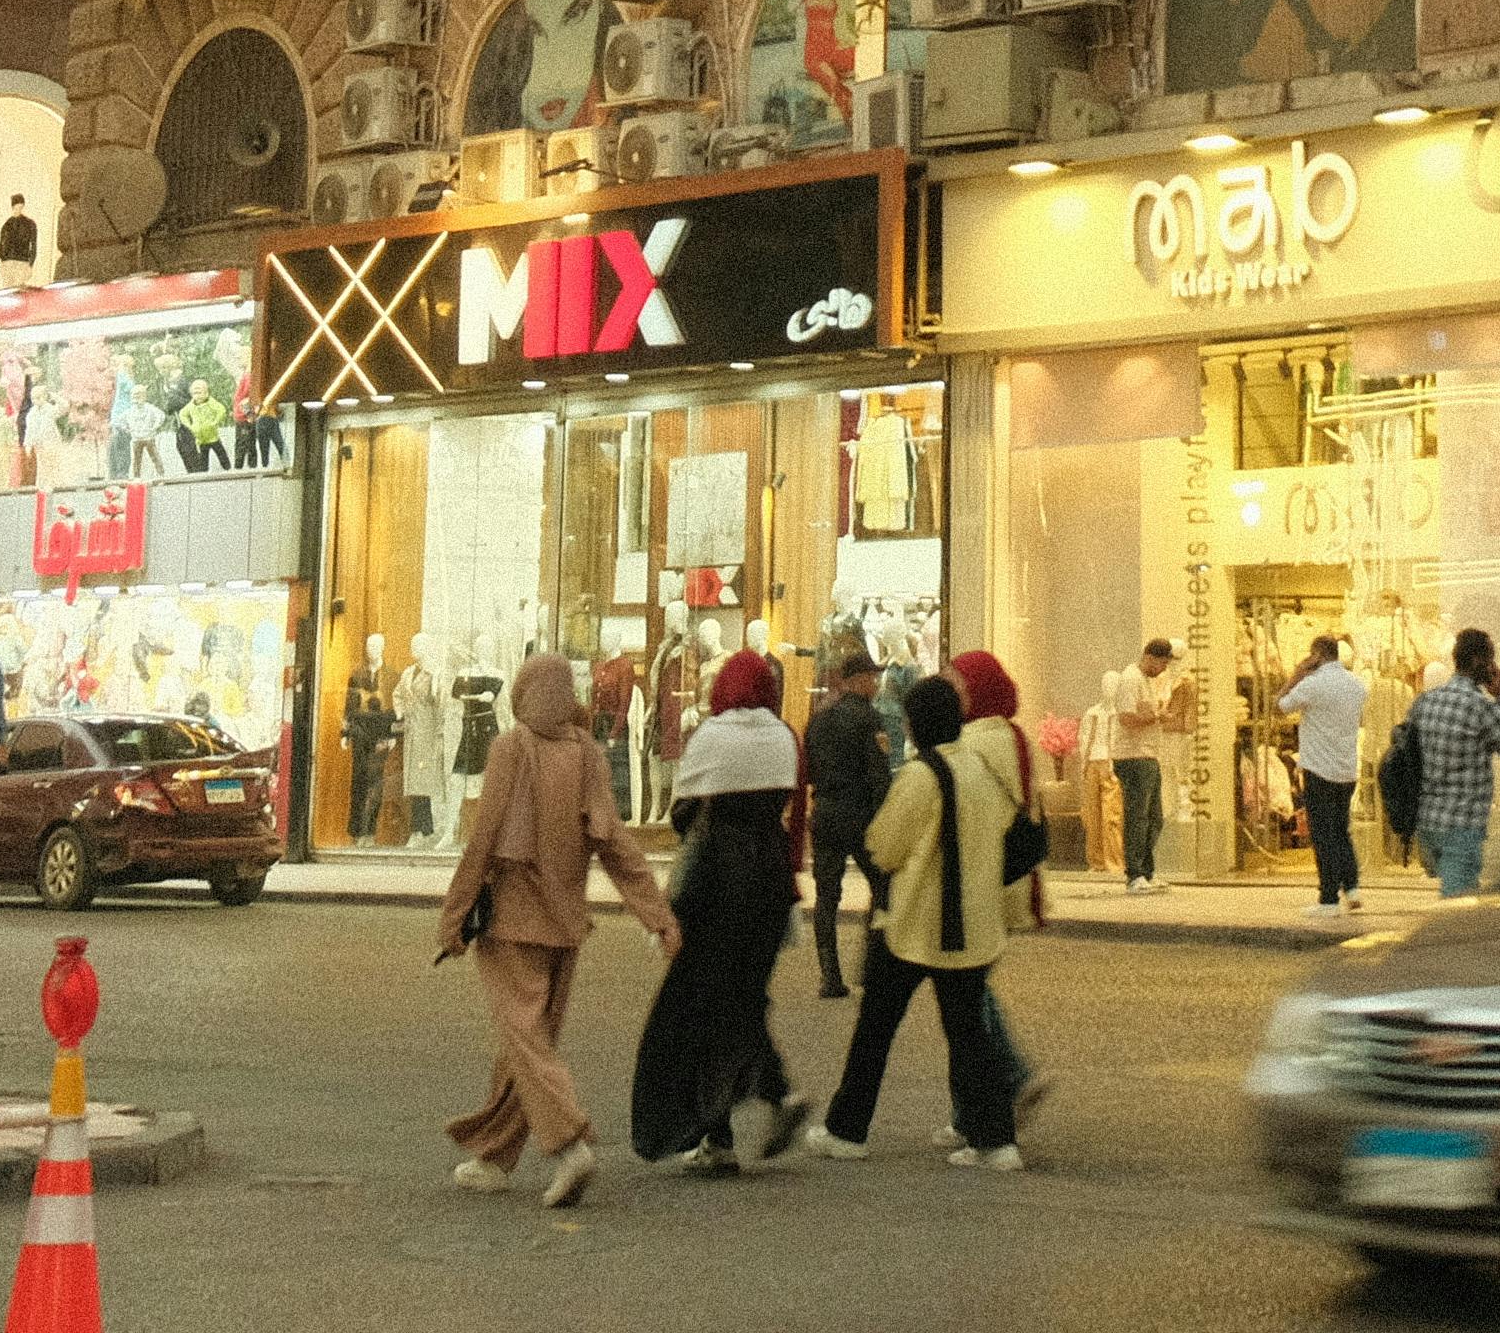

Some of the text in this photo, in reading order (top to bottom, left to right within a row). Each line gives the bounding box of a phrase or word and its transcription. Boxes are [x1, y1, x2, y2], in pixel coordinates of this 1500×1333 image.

[1125, 139, 1359, 263] mab
[458, 217, 690, 365] MIX
[1170, 261, 1311, 299] Kids Wear
